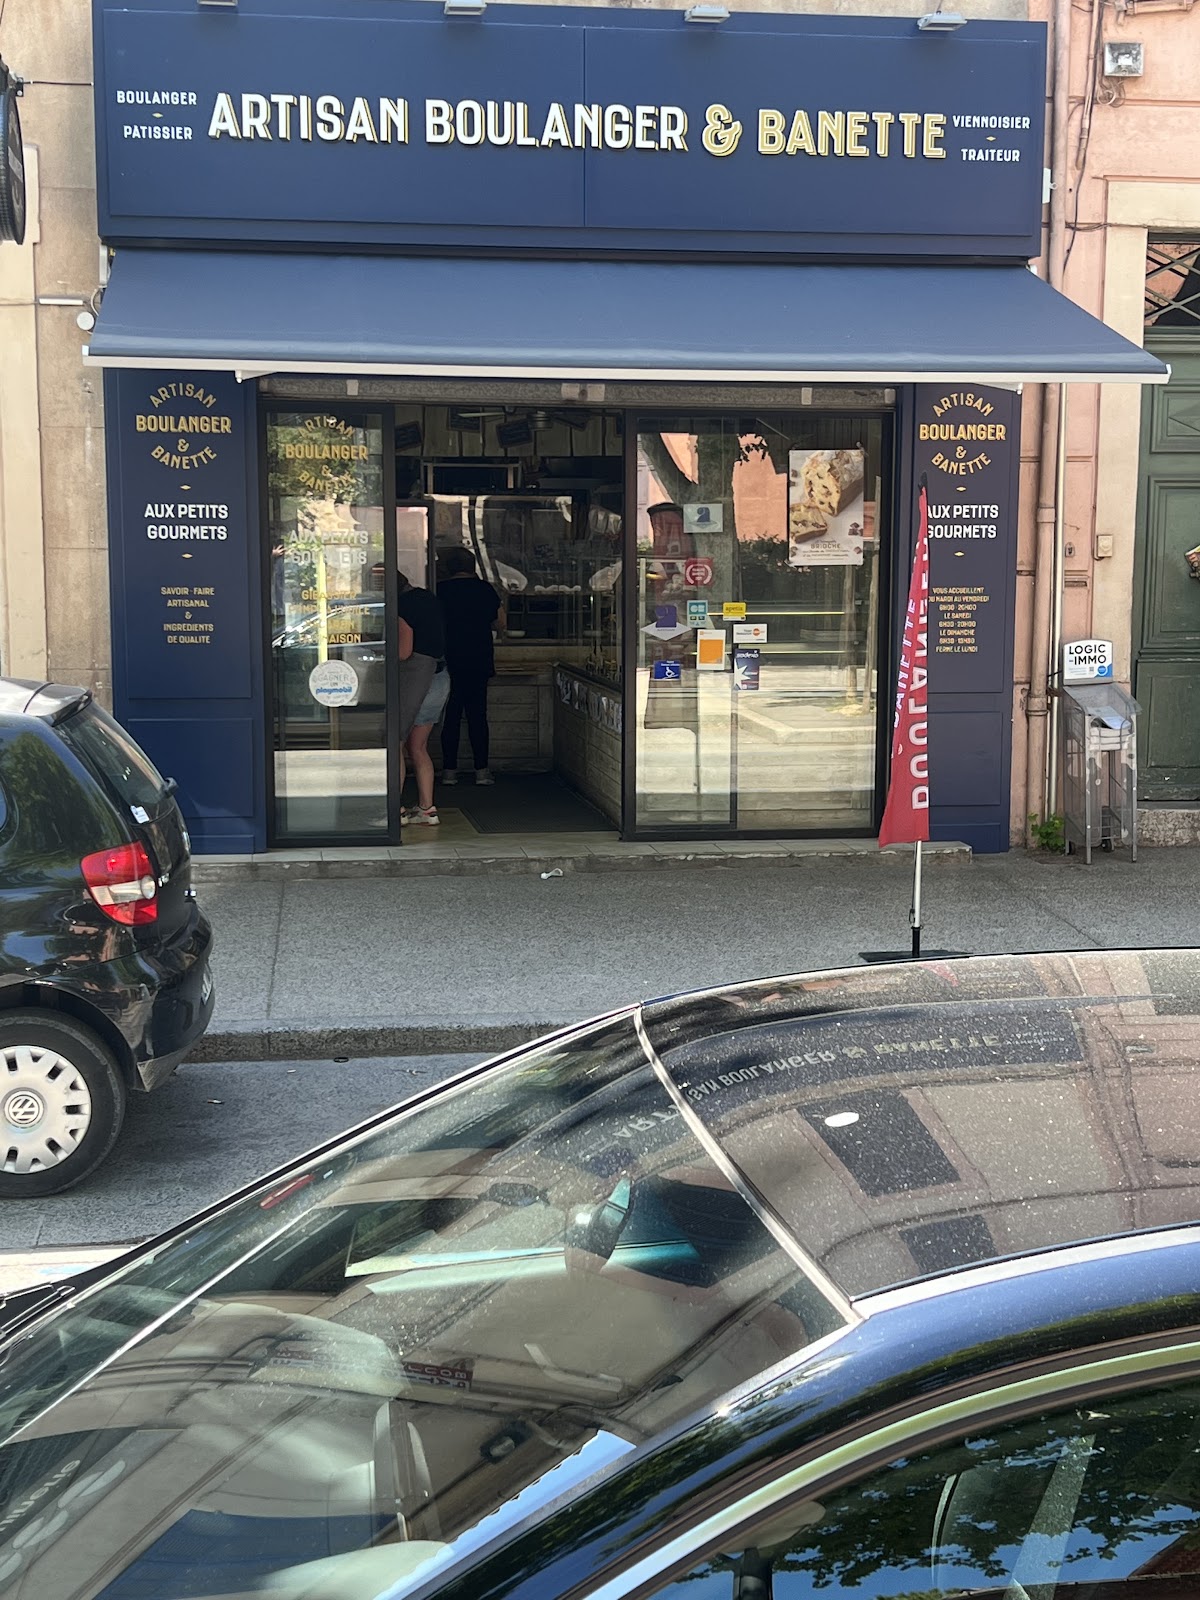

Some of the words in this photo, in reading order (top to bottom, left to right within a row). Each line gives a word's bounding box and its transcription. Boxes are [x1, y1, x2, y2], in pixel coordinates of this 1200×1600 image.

[116, 91, 197, 105] BOULANGER
[208, 92, 409, 144] ARTISAN
[425, 98, 688, 152] BOULANGER
[702, 103, 743, 157] &
[758, 108, 947, 159] BANETTE
[952, 115, 1031, 129] VIENNOISIER
[961, 148, 1021, 162] TRAITEUR
[149, 382, 217, 408] ARTISAN
[932, 392, 994, 418] ARTISAN
[136, 414, 232, 434] BOULANGER
[298, 415, 356, 439] ARTISAN
[919, 424, 1006, 441] BOULANGER
[177, 438, 190, 453] &
[285, 443, 369, 461] BOULANGER
[955, 445, 967, 459] &
[151, 445, 217, 470] BANETTE
[931, 452, 992, 476] BANETTE
[321, 464, 332, 477] &
[144, 503, 175, 518] AUX
[178, 504, 228, 519] PETITS
[953, 504, 999, 519] PETITS
[147, 524, 228, 540] GOURMETS
[166, 599, 210, 608] ARTISANAL
[184, 610, 193, 620] &
[167, 635, 178, 643] DE
[1068, 644, 1106, 655] LOGIC
[315, 686, 353, 695] playmobil
